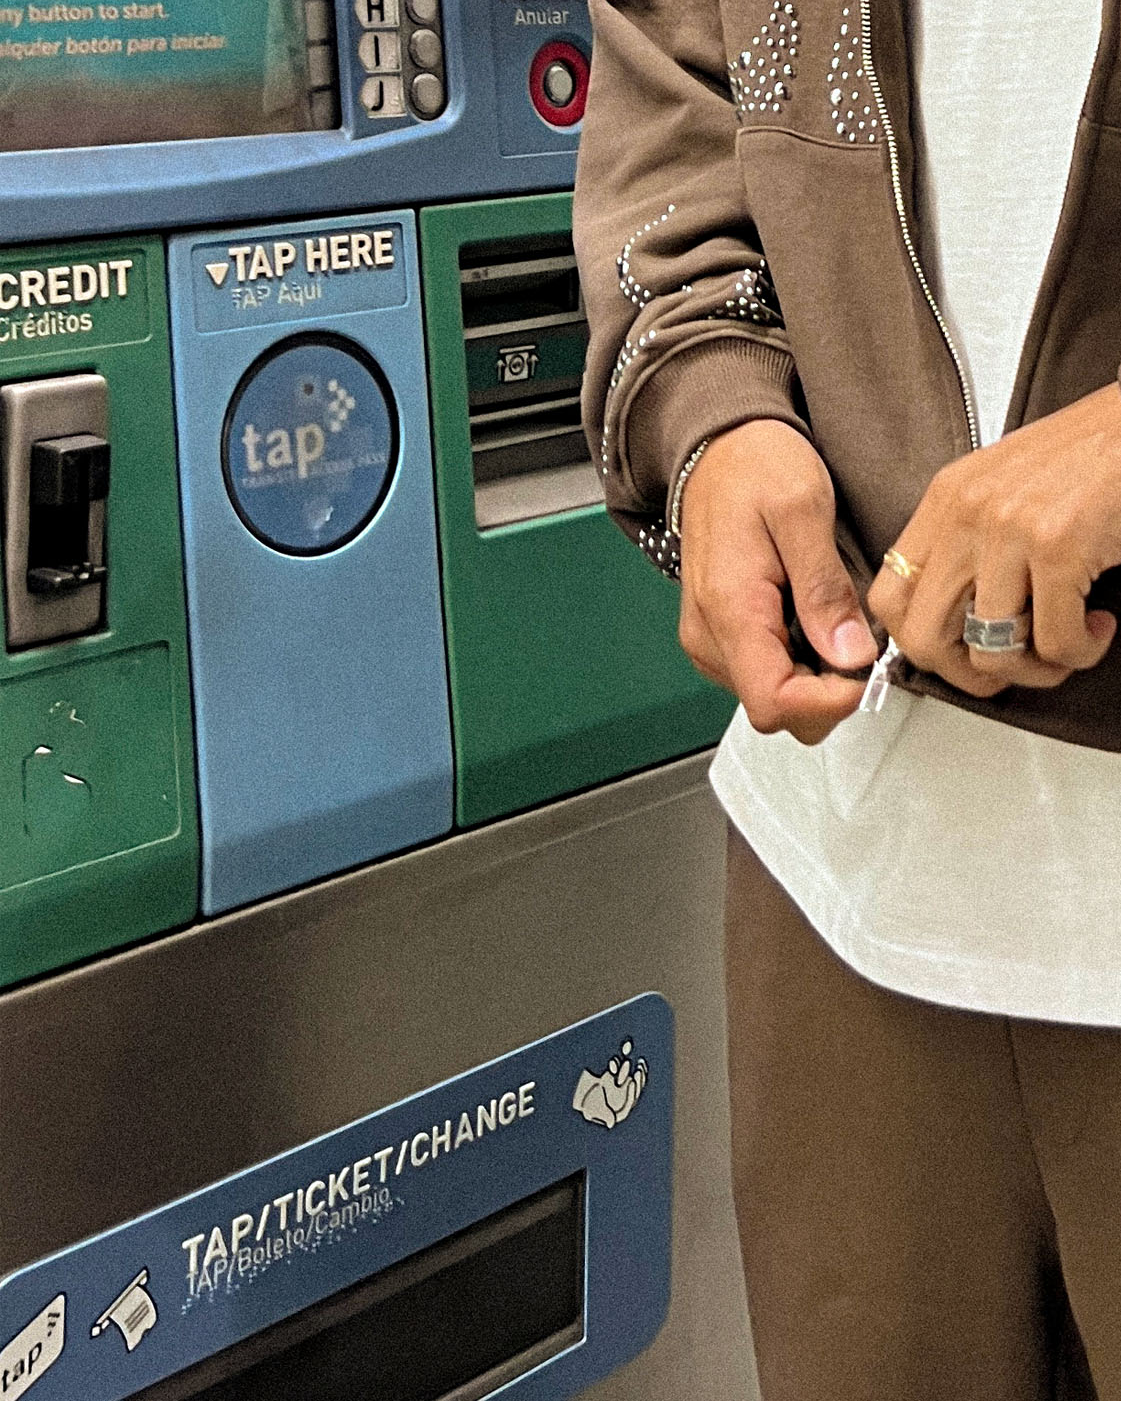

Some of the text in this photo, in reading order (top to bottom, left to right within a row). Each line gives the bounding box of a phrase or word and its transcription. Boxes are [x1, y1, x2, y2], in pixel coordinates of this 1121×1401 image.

[28, 3, 94, 23] button
[98, 4, 119, 20] to
[122, 2, 170, 20] start.
[514, 8, 570, 25] Anular
[66, 36, 123, 55] botón
[127, 37, 168, 56] para
[374, 35, 380, 67] I
[371, 80, 384, 111] J
[228, 230, 395, 282] TAP HERE
[0, 259, 133, 310] CREDIT
[232, 285, 272, 310] TAP
[0, 310, 93, 342] Créditos
[242, 423, 325, 479] tap
[182, 1081, 536, 1275] TAP/TICKET/CHANGE
[187, 1185, 391, 1296] TAP/Boleto/Cambio
[2, 1342, 42, 1393] tap
